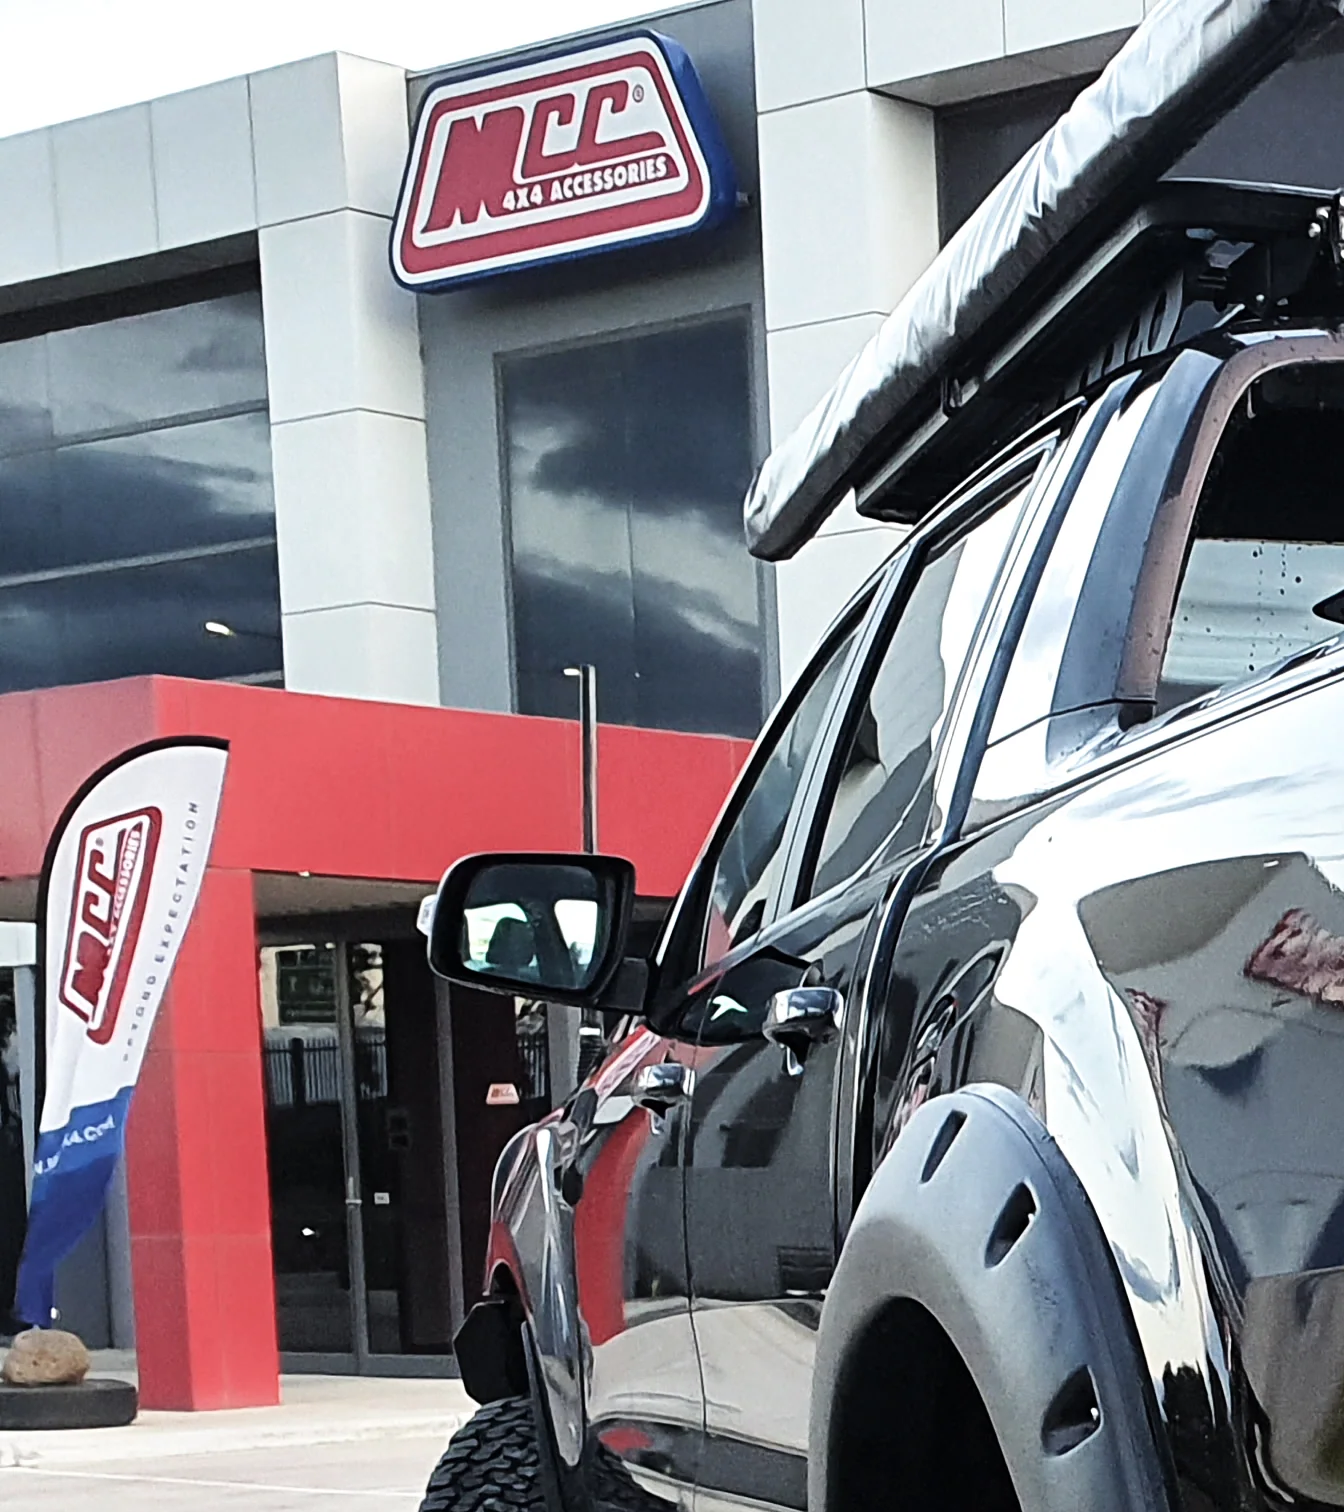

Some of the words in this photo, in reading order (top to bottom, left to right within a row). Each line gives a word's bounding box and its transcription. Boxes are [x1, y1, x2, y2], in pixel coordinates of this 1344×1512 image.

[421, 80, 667, 234] MCC
[502, 184, 543, 211] 4X4
[551, 155, 668, 202] ACCESSORIES
[154, 802, 199, 963] EXPECTATION
